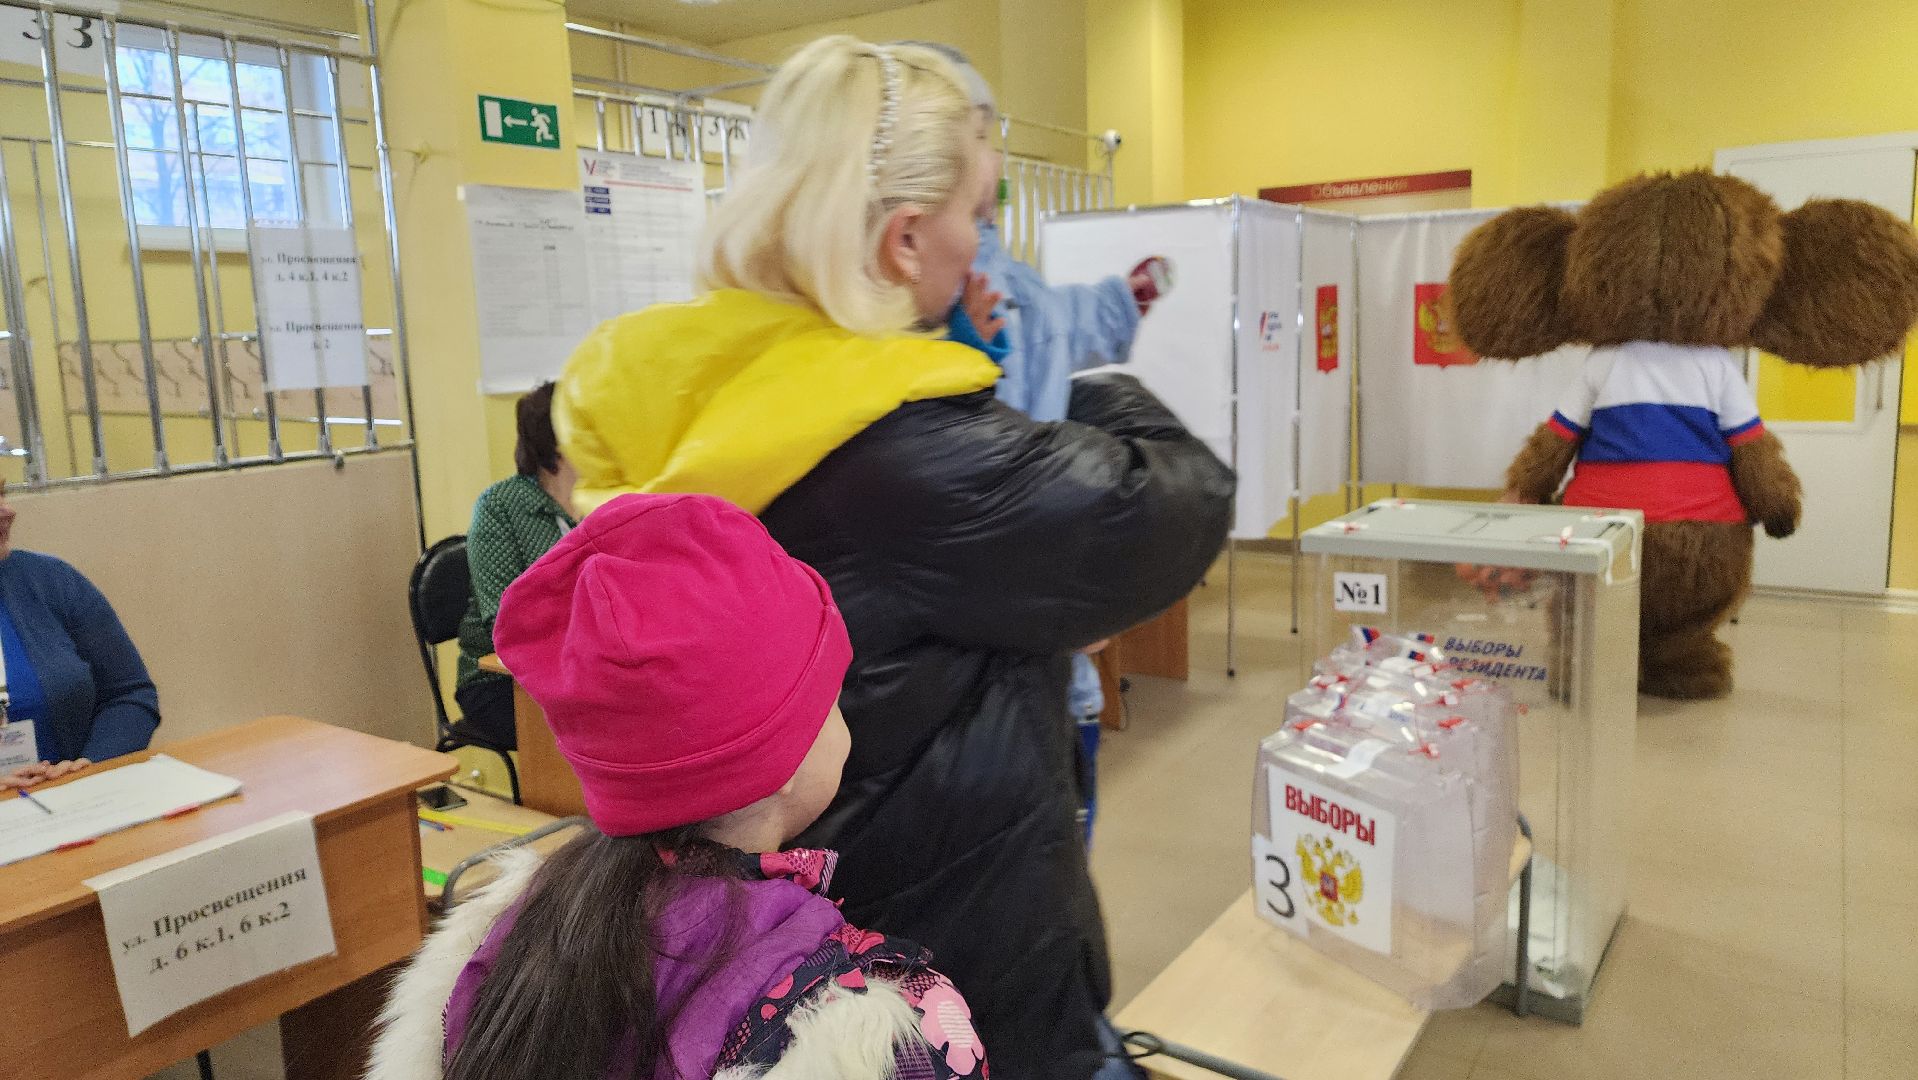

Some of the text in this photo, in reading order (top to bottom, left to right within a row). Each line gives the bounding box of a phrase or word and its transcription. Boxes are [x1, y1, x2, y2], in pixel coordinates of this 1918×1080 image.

[1444, 636, 1524, 658] ВЫБОРЫ
[1450, 656, 1548, 681] РЕЗИДЕНТА
[1286, 784, 1375, 846] ВЫБОРЫ
[122, 867, 306, 954] ул. Просвещения
[175, 940, 188, 960] 6
[239, 914, 251, 934] 6
[258, 901, 291, 927] к.2
